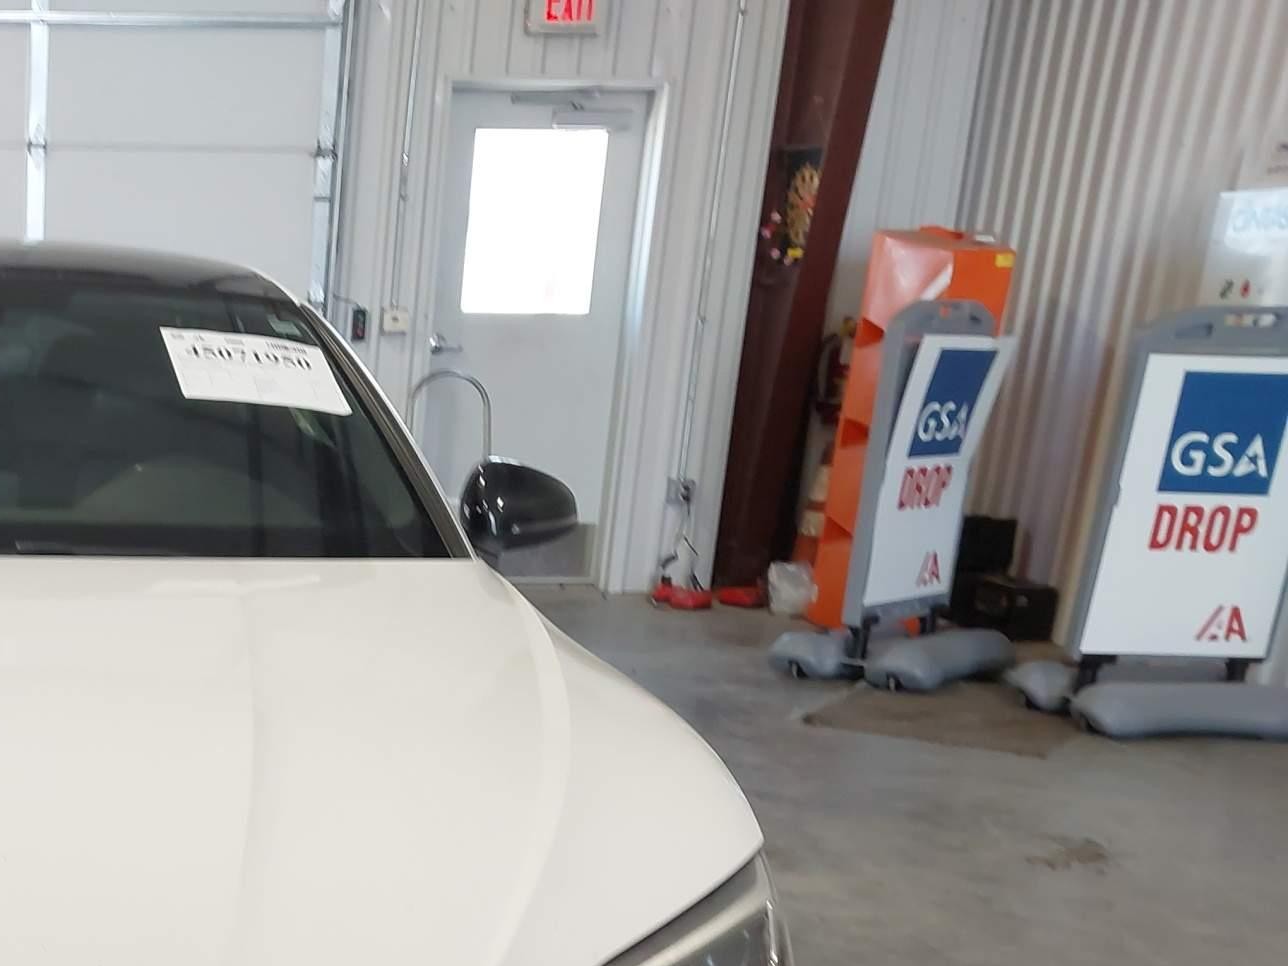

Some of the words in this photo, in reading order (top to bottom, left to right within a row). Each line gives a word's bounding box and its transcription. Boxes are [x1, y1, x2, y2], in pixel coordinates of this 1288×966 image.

[916, 400, 970, 443] GSA
[1170, 430, 1269, 479] GSA
[897, 464, 953, 511] DROP
[1148, 503, 1259, 553] DROP
